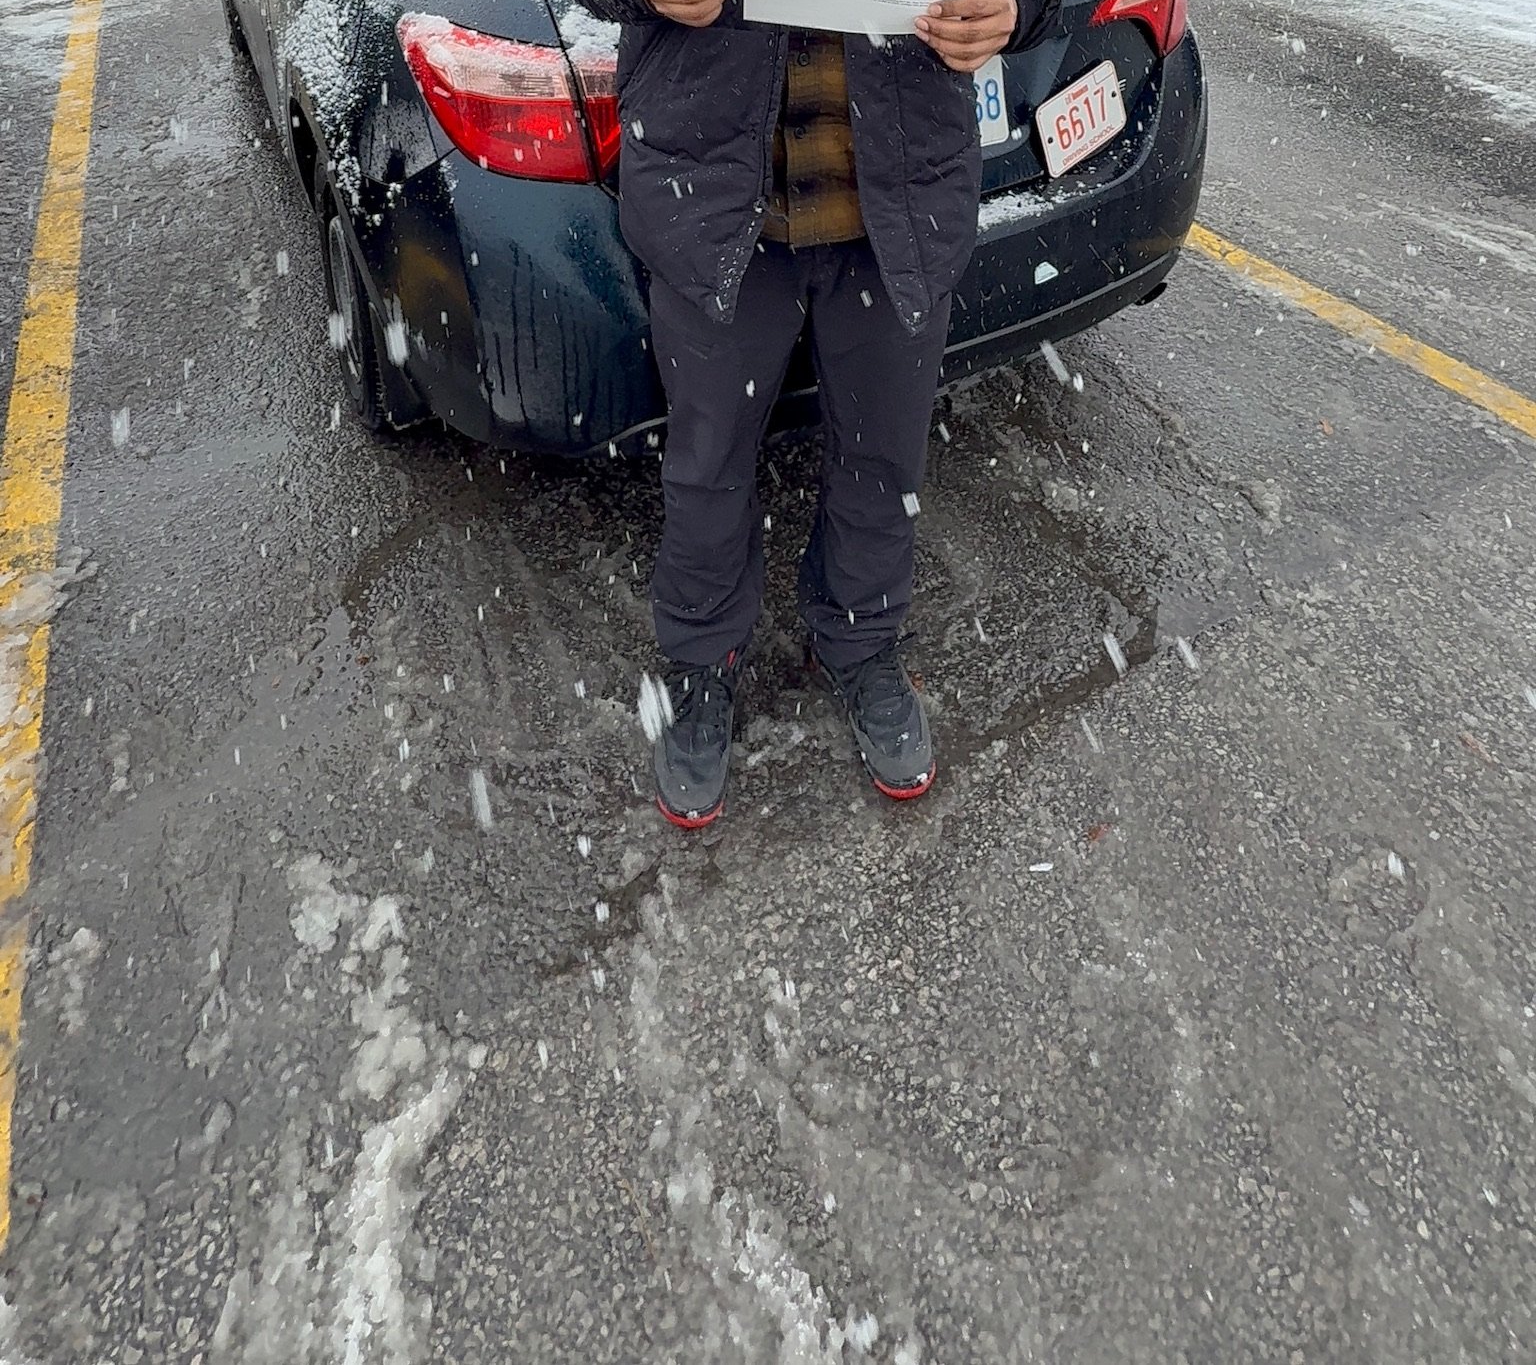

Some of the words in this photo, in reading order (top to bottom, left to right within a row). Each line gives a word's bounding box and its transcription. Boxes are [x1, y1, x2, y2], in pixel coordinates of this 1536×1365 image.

[1055, 86, 1106, 150] 6617
[1062, 143, 1089, 166] DRIVING
[1089, 123, 1115, 146] SCHOOL
